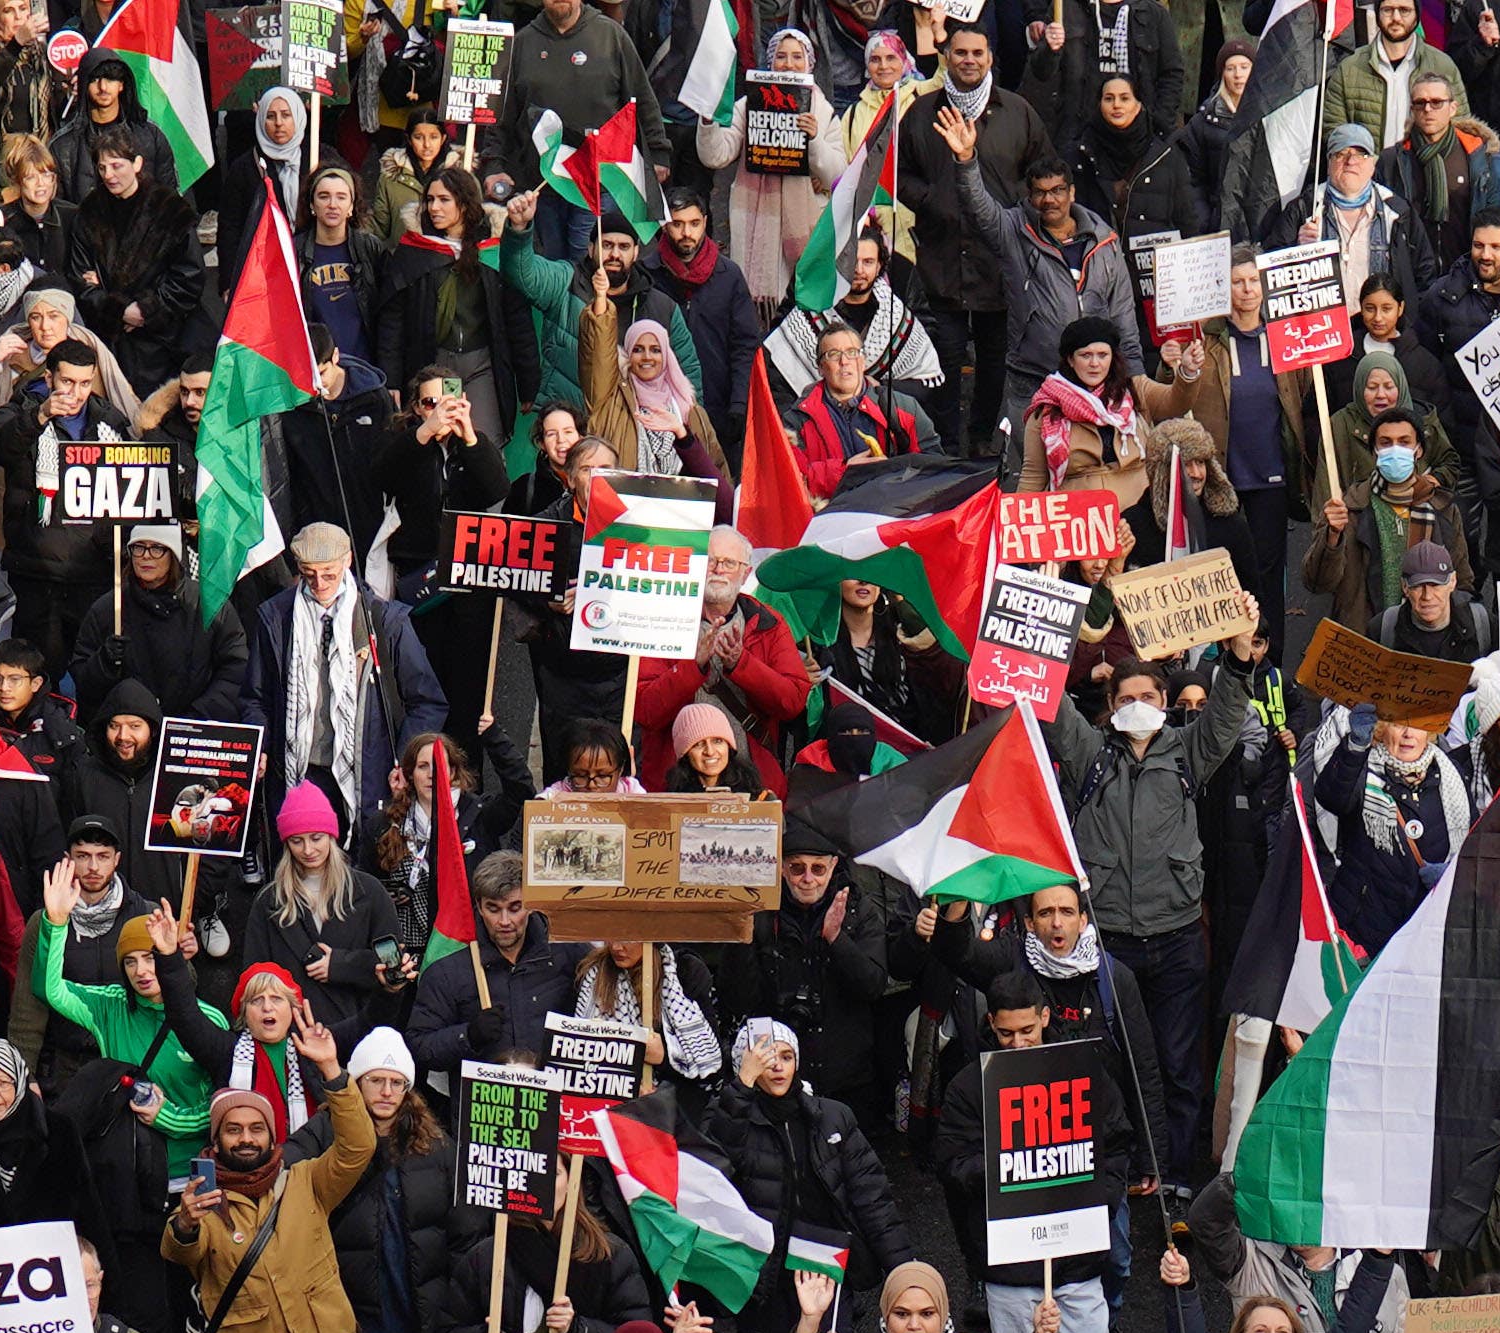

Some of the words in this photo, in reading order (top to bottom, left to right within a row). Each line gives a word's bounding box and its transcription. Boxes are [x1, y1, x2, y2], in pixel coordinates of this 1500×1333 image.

[51, 44, 84, 61] STOP
[454, 35, 484, 49] FROM
[487, 37, 504, 51] THE
[450, 78, 502, 94] PALESTINE
[748, 129, 806, 149] WELCOME
[1265, 259, 1334, 289] FREEDOM
[1268, 289, 1343, 319] PALESTINE
[1465, 345, 1500, 377] You
[65, 447, 101, 464] STOP
[105, 447, 170, 464] BOMBING
[64, 466, 173, 519] GAZA
[454, 515, 556, 570] FREE
[602, 537, 694, 574] FREE
[451, 563, 552, 592] PALESTINE
[585, 571, 700, 597] PALESTINE
[996, 585, 1075, 627] FREEDOM
[983, 616, 1068, 660] PALESTINE
[631, 831, 676, 852] SPOT
[636, 858, 673, 877] THE
[550, 1033, 635, 1064] FREEDOM
[472, 1081, 514, 1107] FROM
[519, 1089, 547, 1110] THE
[998, 1077, 1092, 1149] FREE
[469, 1145, 547, 1174] PALESTINE
[999, 1140, 1094, 1183] PALESTINE
